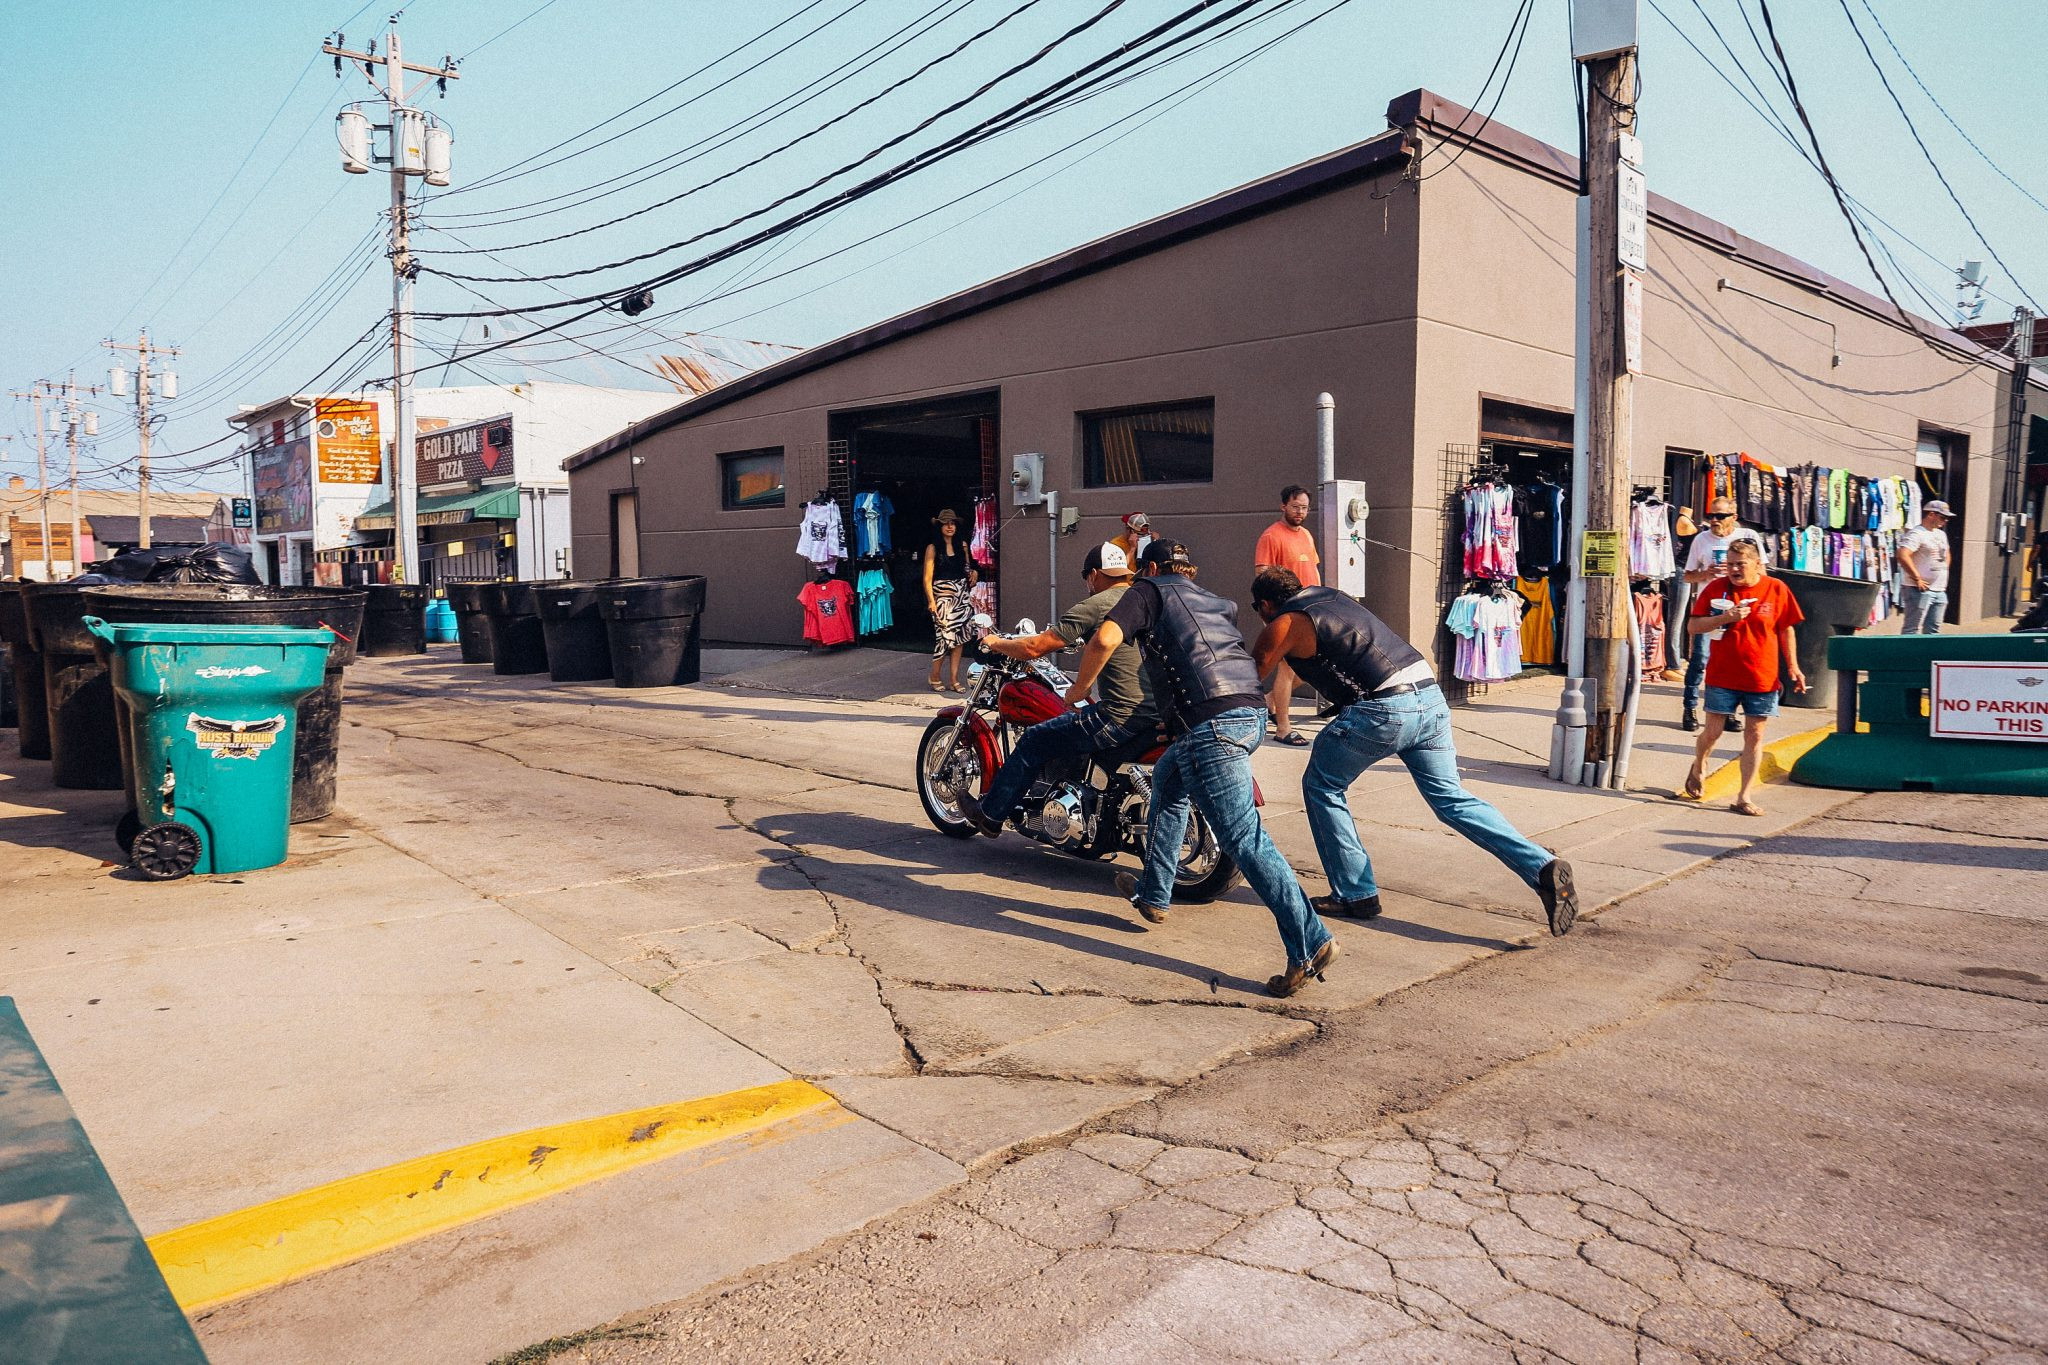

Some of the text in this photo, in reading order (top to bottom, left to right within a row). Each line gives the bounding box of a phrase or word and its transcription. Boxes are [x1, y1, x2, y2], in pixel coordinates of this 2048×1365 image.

[423, 429, 478, 461] GOLD PAN
[438, 460, 464, 480] PIZZA
[440, 510, 466, 524] BUFFET
[1943, 699, 2048, 714] NO PARKIN
[1995, 718, 2043, 732] THIS
[199, 732, 274, 743] RUSS BROWN
